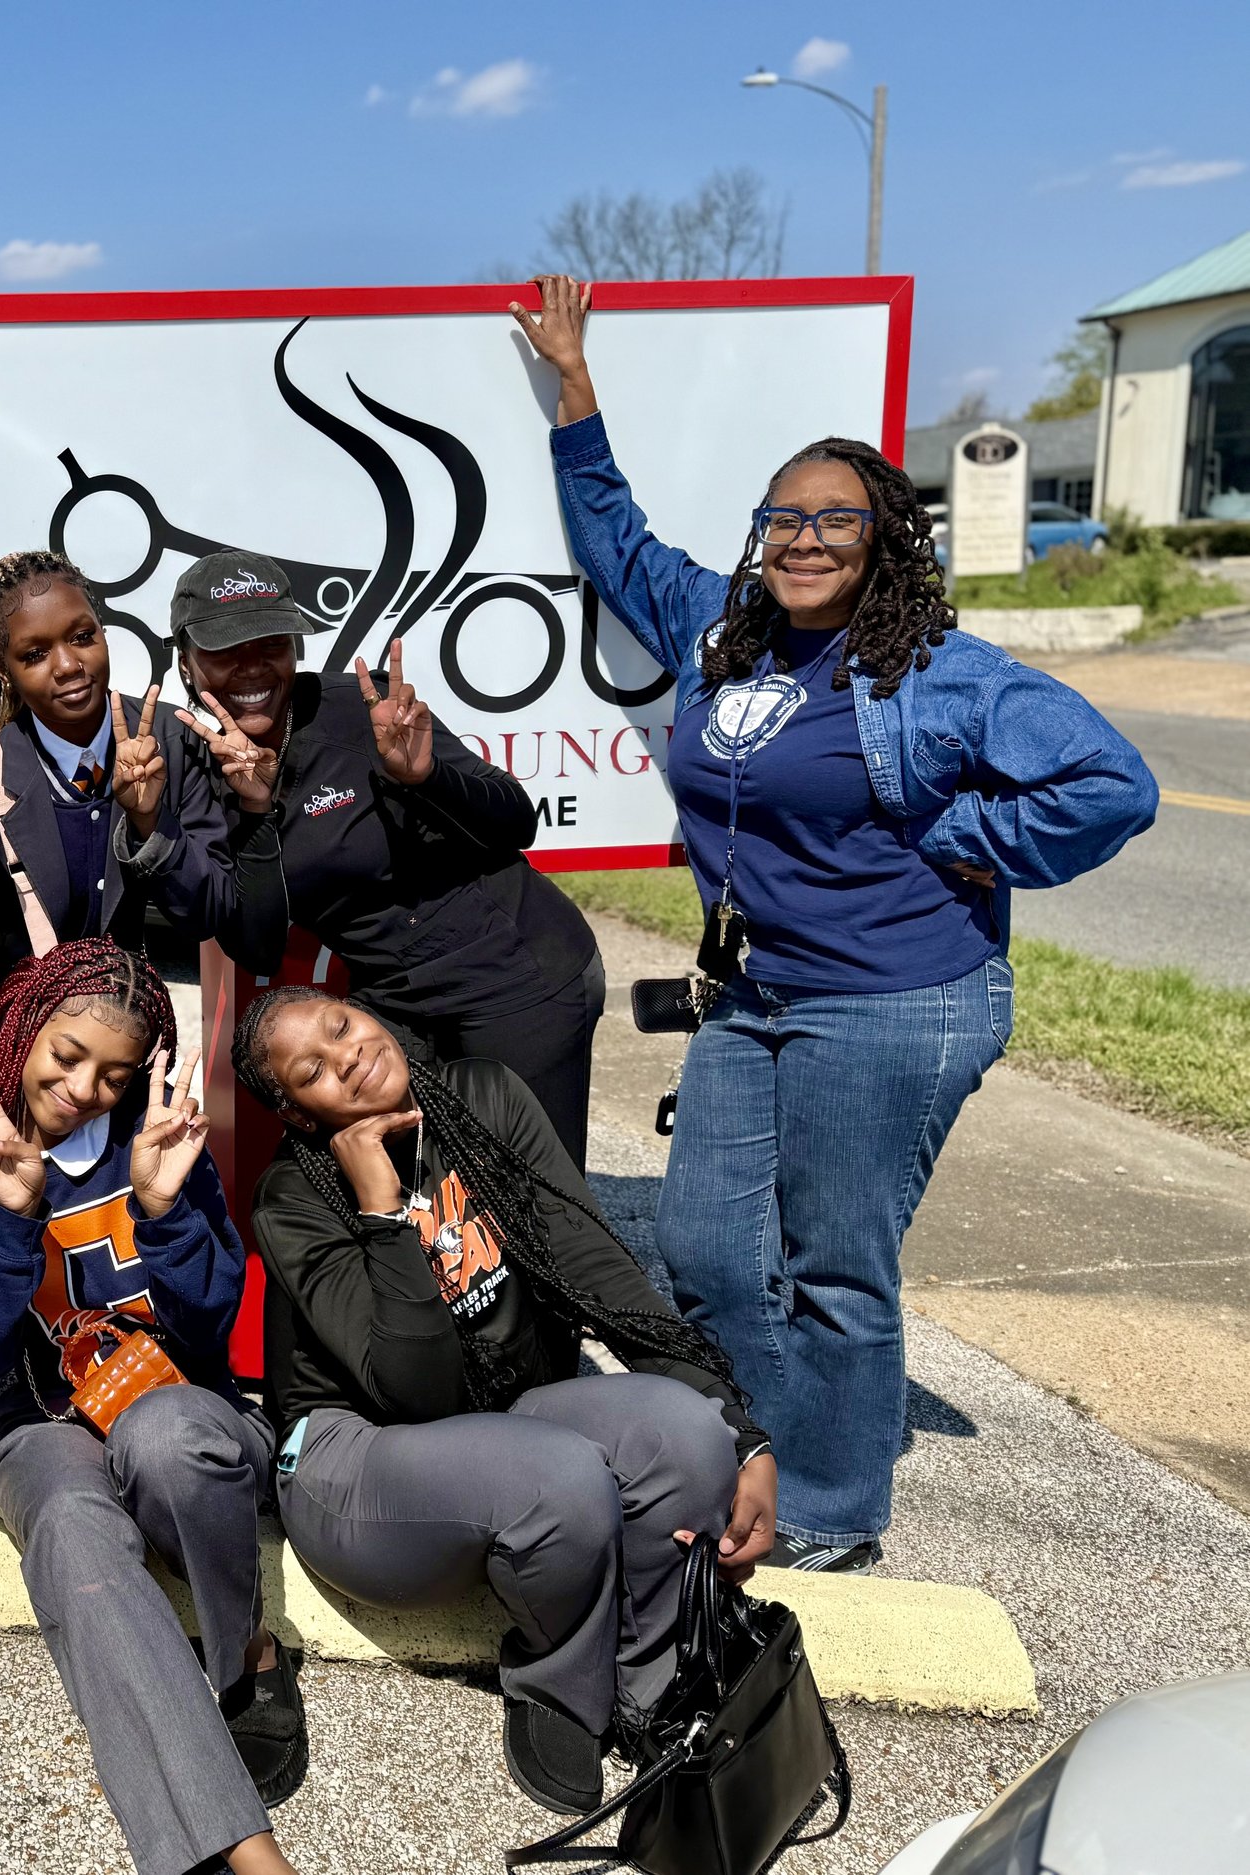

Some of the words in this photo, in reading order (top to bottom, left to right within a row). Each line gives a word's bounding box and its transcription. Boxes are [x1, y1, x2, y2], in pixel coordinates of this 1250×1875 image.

[721, 711, 757, 729] YERS
[456, 725, 673, 781] OUNG
[535, 795, 577, 827] ME
[451, 1289, 481, 1315] ALES
[479, 1264, 510, 1294] TRACK
[467, 1290, 497, 1319] 2025
